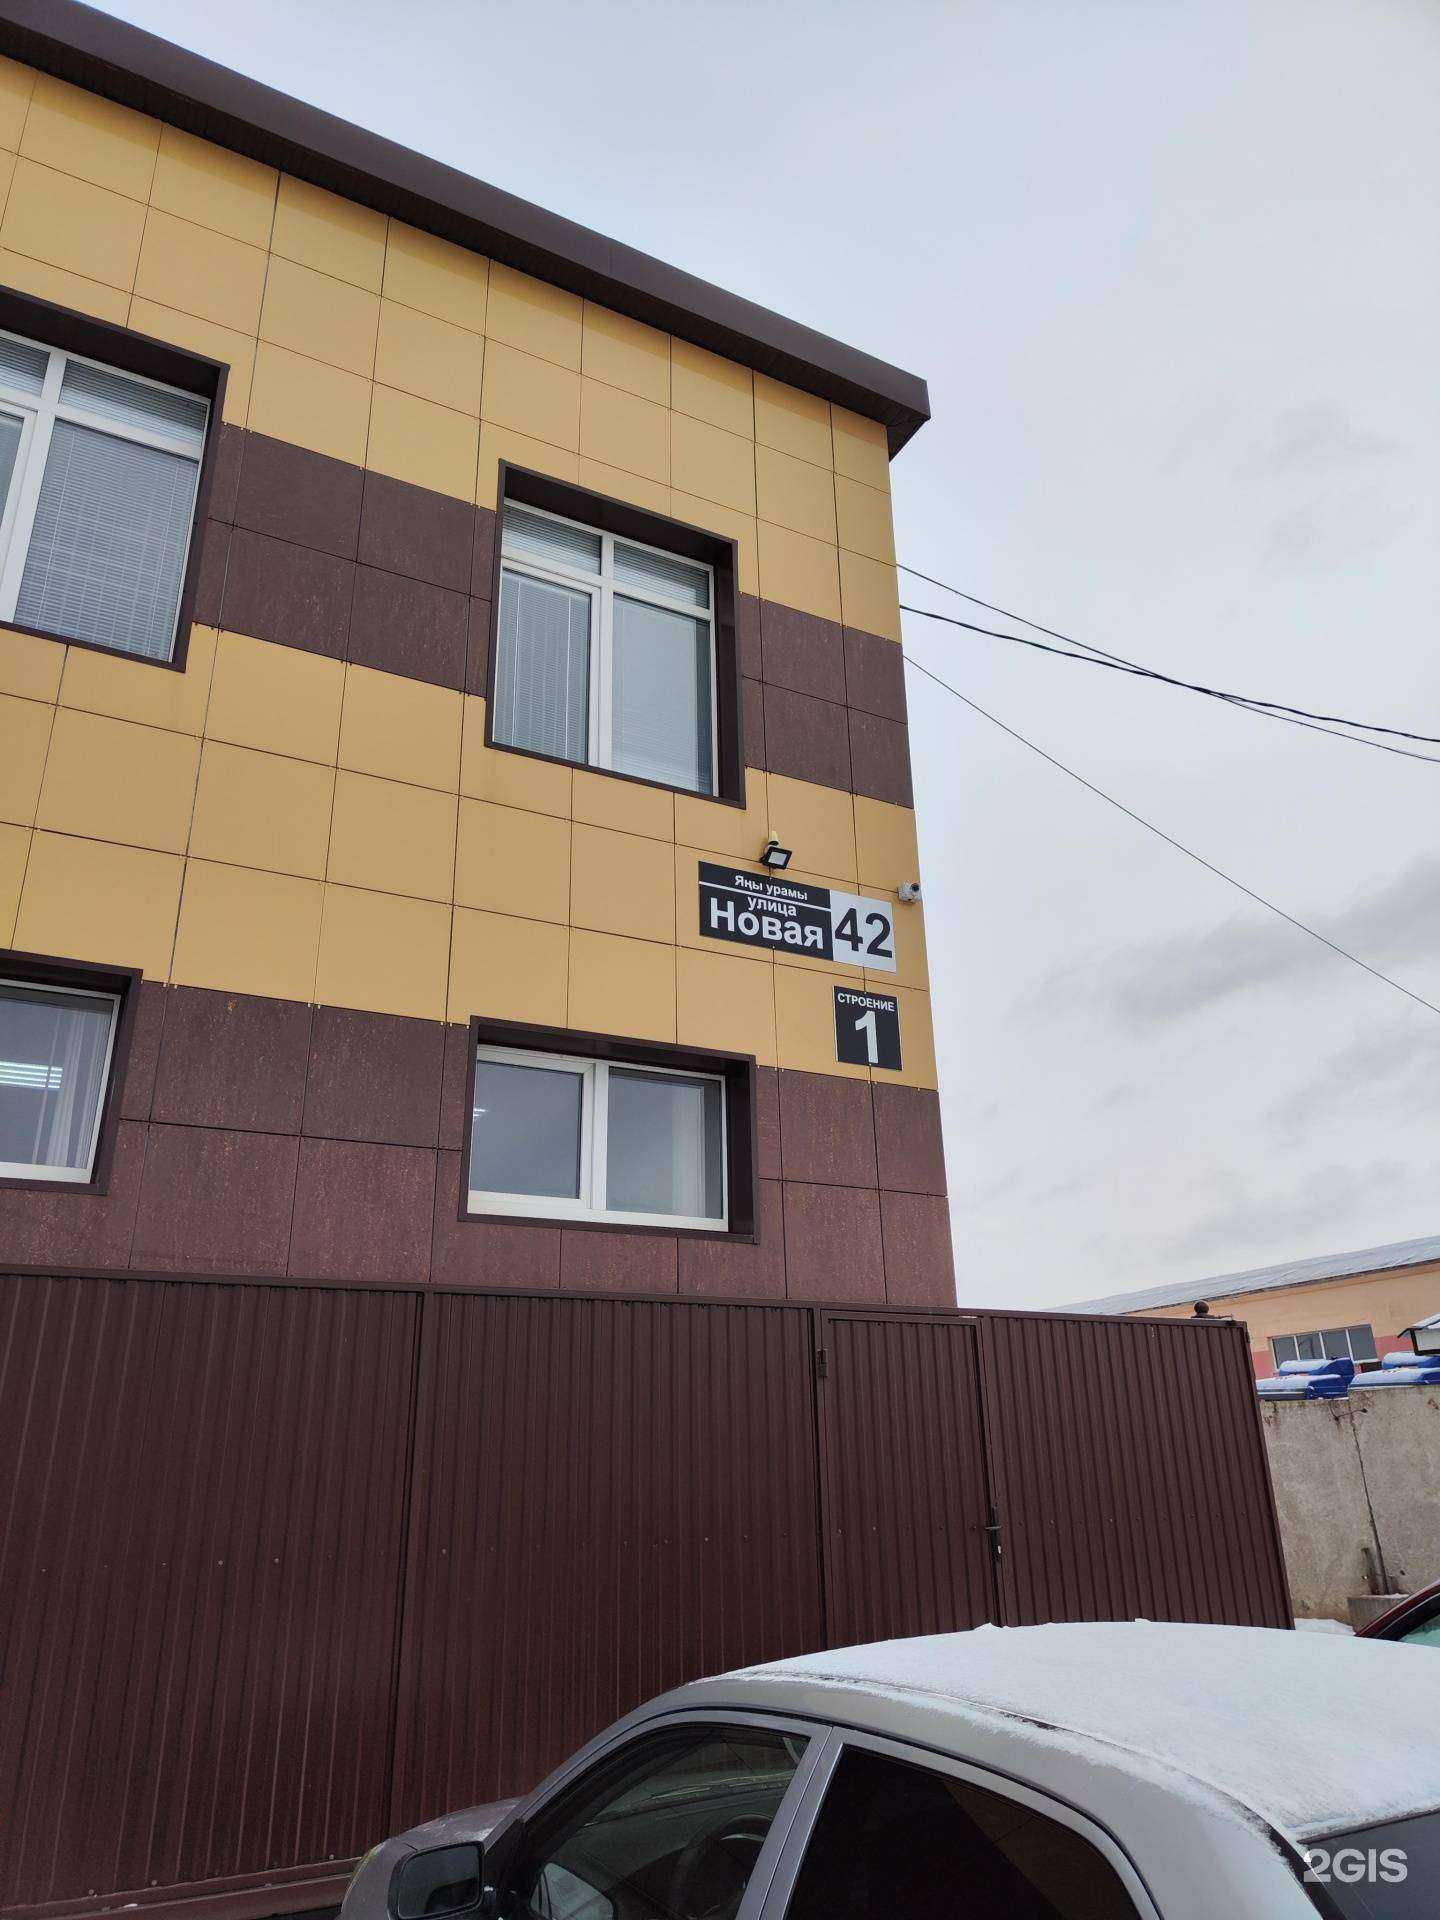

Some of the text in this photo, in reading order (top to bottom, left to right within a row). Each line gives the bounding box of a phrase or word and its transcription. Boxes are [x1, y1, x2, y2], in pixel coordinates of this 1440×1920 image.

[748, 896, 797, 916] улица
[766, 883, 808, 901] урамы
[710, 897, 824, 949] Новая
[834, 907, 893, 958] 42
[837, 993, 895, 1012] СТРОЕНИЕ
[855, 1010, 879, 1063] 1
